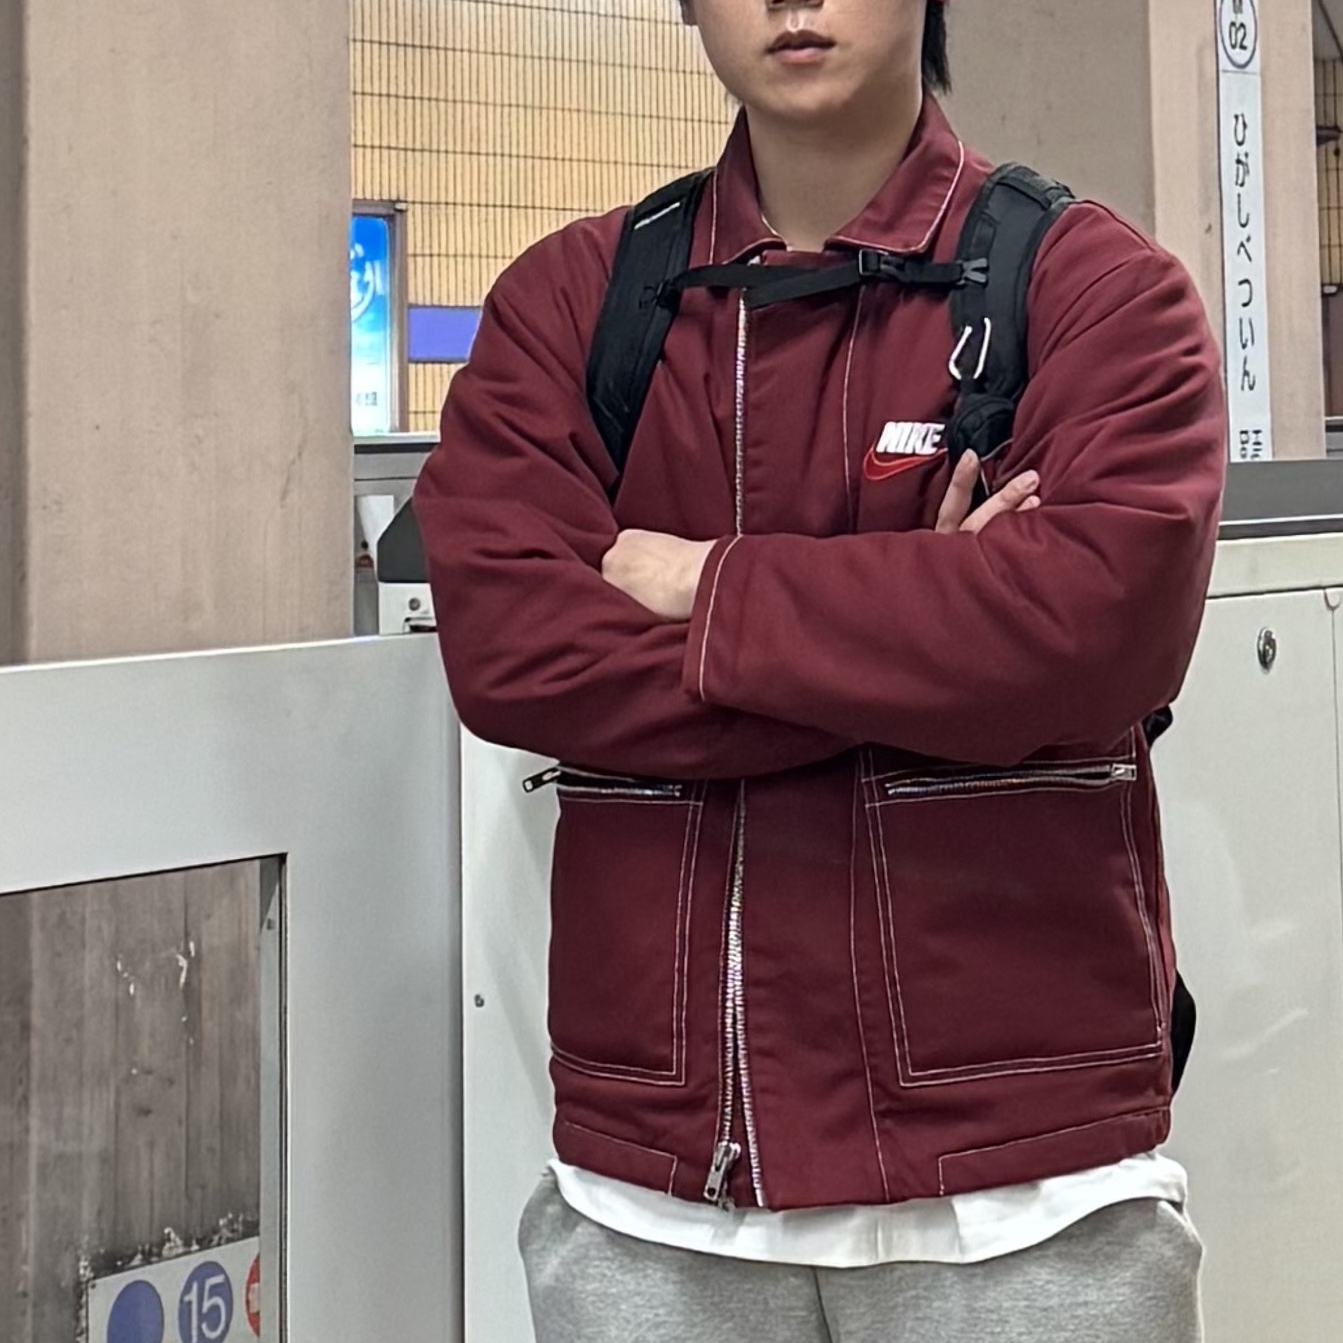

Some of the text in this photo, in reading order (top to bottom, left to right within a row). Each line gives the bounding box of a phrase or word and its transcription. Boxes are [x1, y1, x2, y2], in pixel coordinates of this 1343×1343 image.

[1228, 20, 1248, 51] 02
[1233, 112, 1256, 392] ひがしべついん
[875, 421, 945, 455] NIKE
